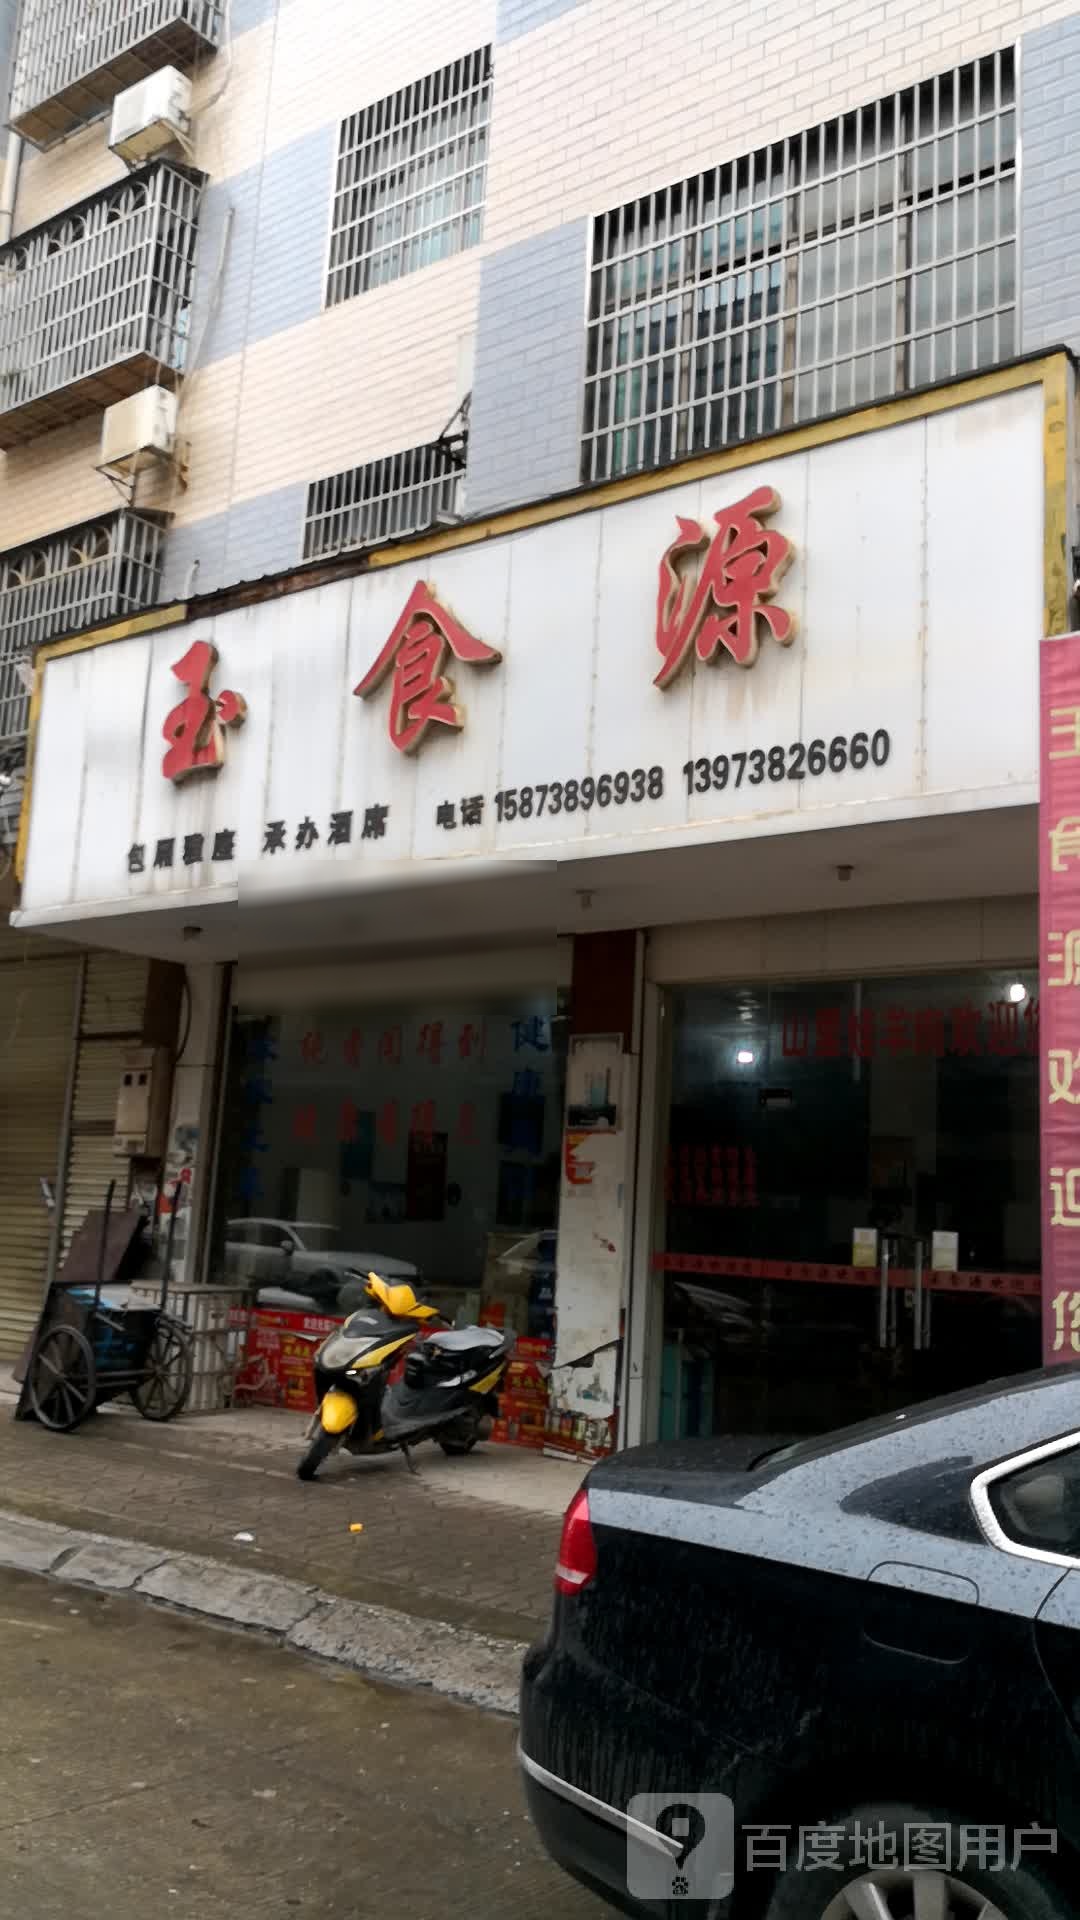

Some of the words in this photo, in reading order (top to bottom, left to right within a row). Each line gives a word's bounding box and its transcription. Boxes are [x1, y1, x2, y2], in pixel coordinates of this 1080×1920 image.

[162, 486, 797, 784] 玉食源
[262, 803, 390, 854] 承办酒席
[436, 795, 484, 830] 电话
[494, 766, 664, 822] 15873896938
[683, 728, 890, 796] 13973826660
